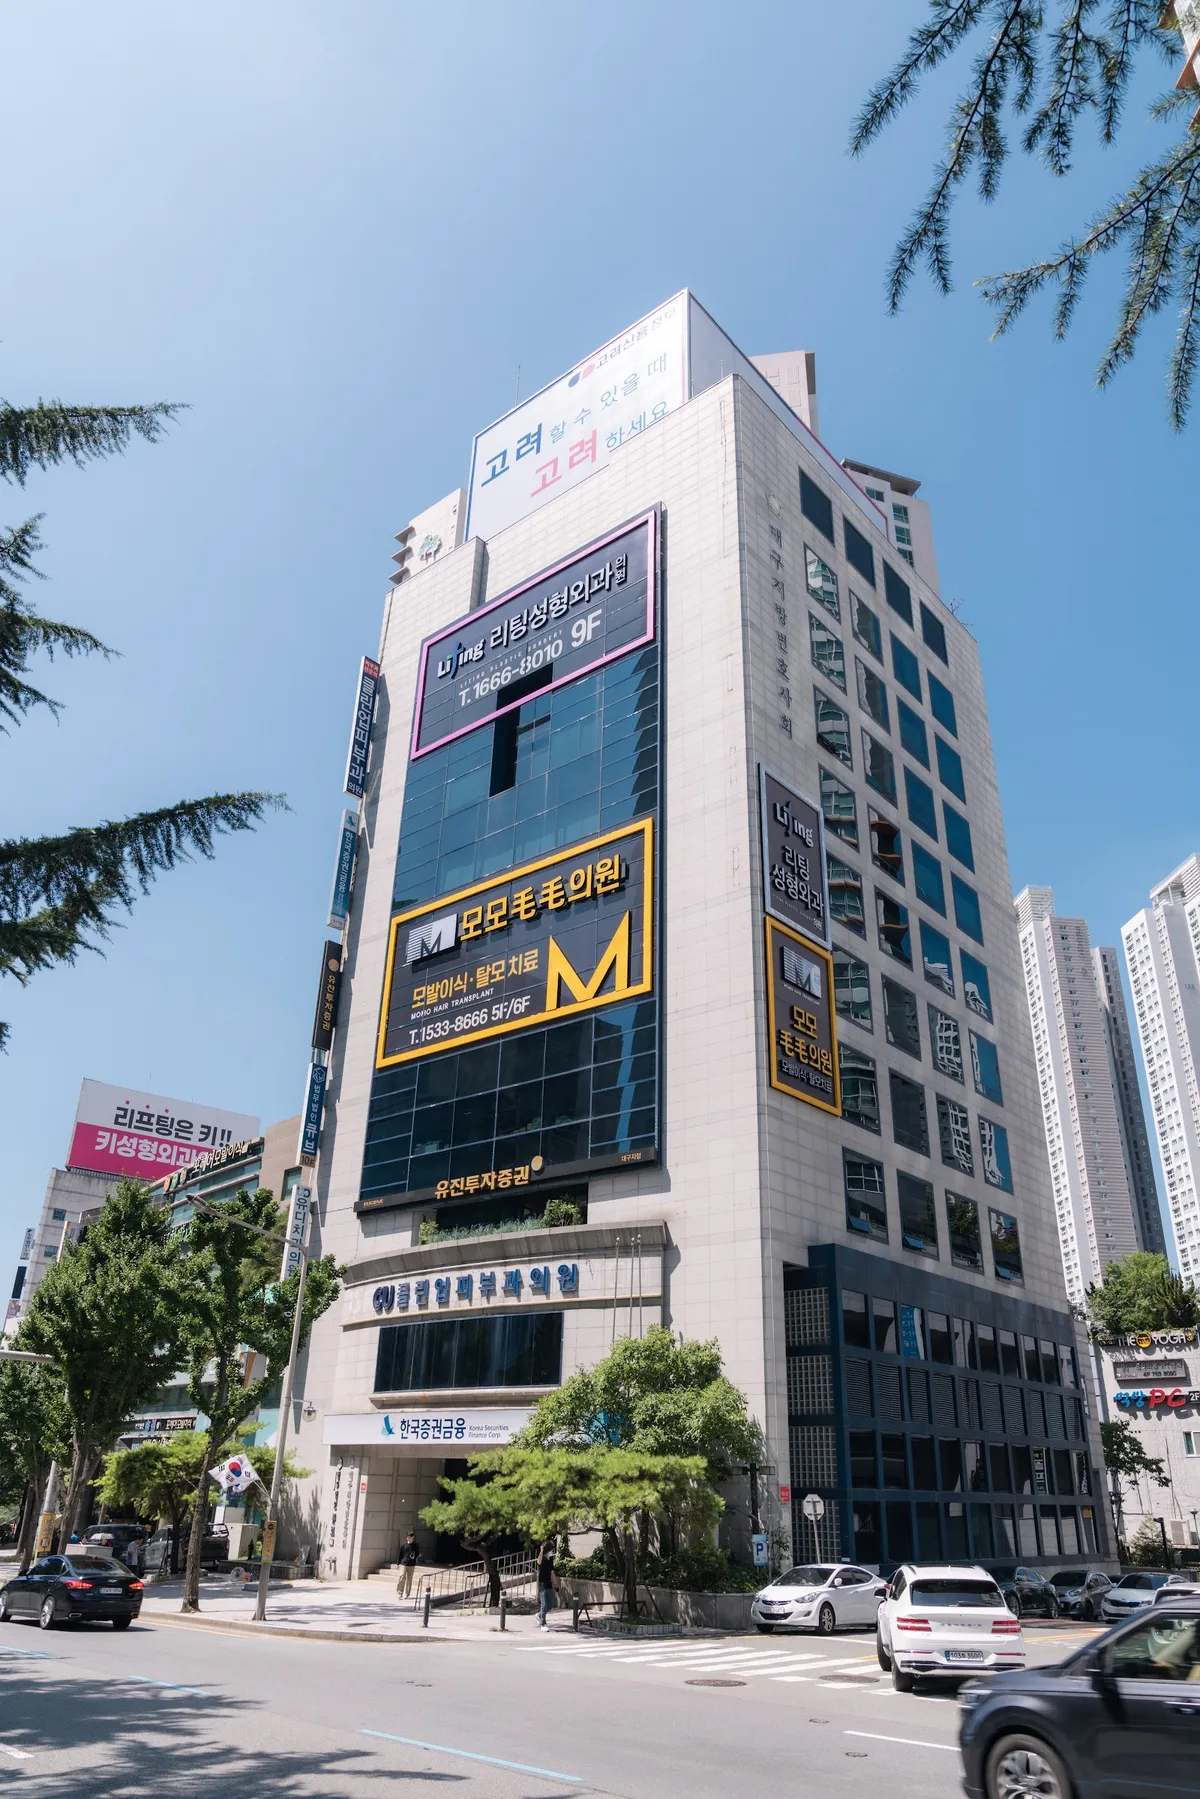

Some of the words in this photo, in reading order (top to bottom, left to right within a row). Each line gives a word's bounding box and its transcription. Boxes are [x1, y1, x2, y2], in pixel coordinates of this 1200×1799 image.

[571, 608, 602, 648] 9F
[784, 845, 810, 881] 리팅
[772, 863, 824, 917] 성형외과
[545, 908, 631, 1013] M
[411, 1008, 432, 1020] MOMO
[433, 1002, 449, 1014] HAIR
[451, 987, 495, 1008] TRANSPLANT
[491, 995, 531, 1020] 5F/6F
[793, 1005, 818, 1039] 모모
[779, 1028, 833, 1077] 毛毛의원
[113, 1106, 194, 1142] 리프팅은
[302, 1122, 318, 1154] 큐브
[301, 1154, 316, 1167] 10F
[434, 1164, 532, 1200] 유진투자증권
[1151, 1331, 1187, 1345] YOGA
[1149, 1388, 1187, 1409] PC
[1189, 1392, 1200, 1401] 2F
[400, 1417, 467, 1440] 한국증권금융
[488, 1432, 502, 1440] Corp.
[756, 1542, 764, 1556] P
